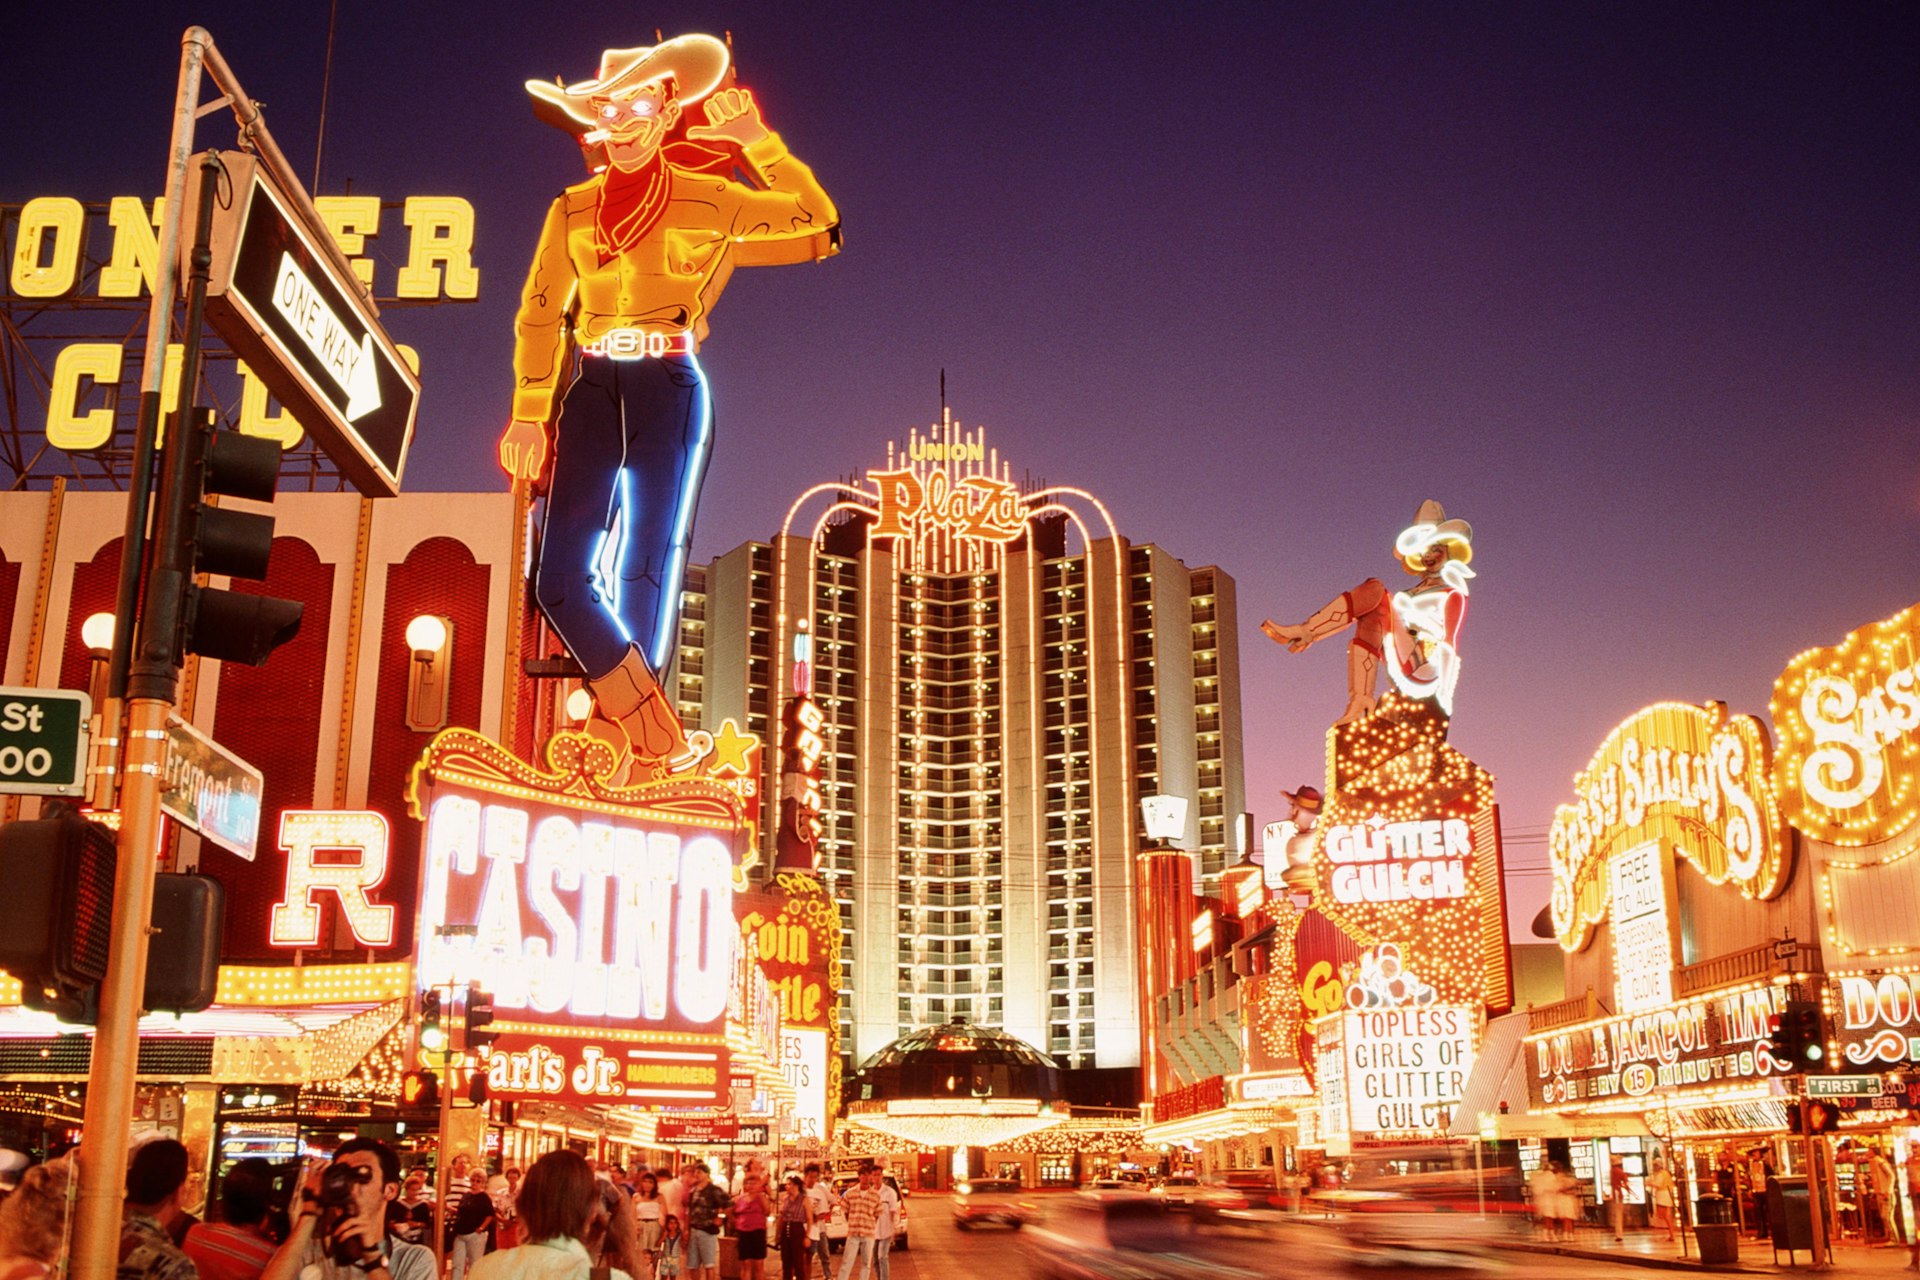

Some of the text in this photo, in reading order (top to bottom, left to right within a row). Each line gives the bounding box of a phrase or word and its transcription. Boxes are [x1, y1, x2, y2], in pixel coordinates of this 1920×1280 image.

[11, 196, 479, 299] ONER
[283, 271, 359, 386] ONE WAY
[910, 443, 984, 461] UNION
[866, 467, 1030, 543] Plaza
[0, 702, 44, 732] St
[1800, 660, 1920, 809] SAS
[163, 735, 234, 824] Fremont
[1325, 818, 1473, 864] GLITTER
[1548, 761, 1619, 938] SASSY
[1331, 860, 1466, 904] GULCH
[1619, 853, 1651, 890] FREE
[417, 794, 733, 1024] CASINO
[1618, 894, 1631, 914] TO
[1841, 973, 1920, 1029] DO
[1357, 1011, 1458, 1038] TOPLESS
[1536, 1024, 1610, 1079] DOUBLE
[1612, 1004, 1709, 1075] JACKPOT
[572, 1046, 624, 1096] Jr.
[626, 1064, 717, 1086] HAMBURGERS
[1355, 1040, 1465, 1069] GIRLS OF
[1567, 1054, 1753, 1100] EVERY 15 MINUTES
[1365, 1071, 1465, 1098] GLITTER
[1818, 1080, 1859, 1093] FIRST
[1871, 1096, 1898, 1109] BEER
[1728, 1102, 1774, 1128] BONUS
